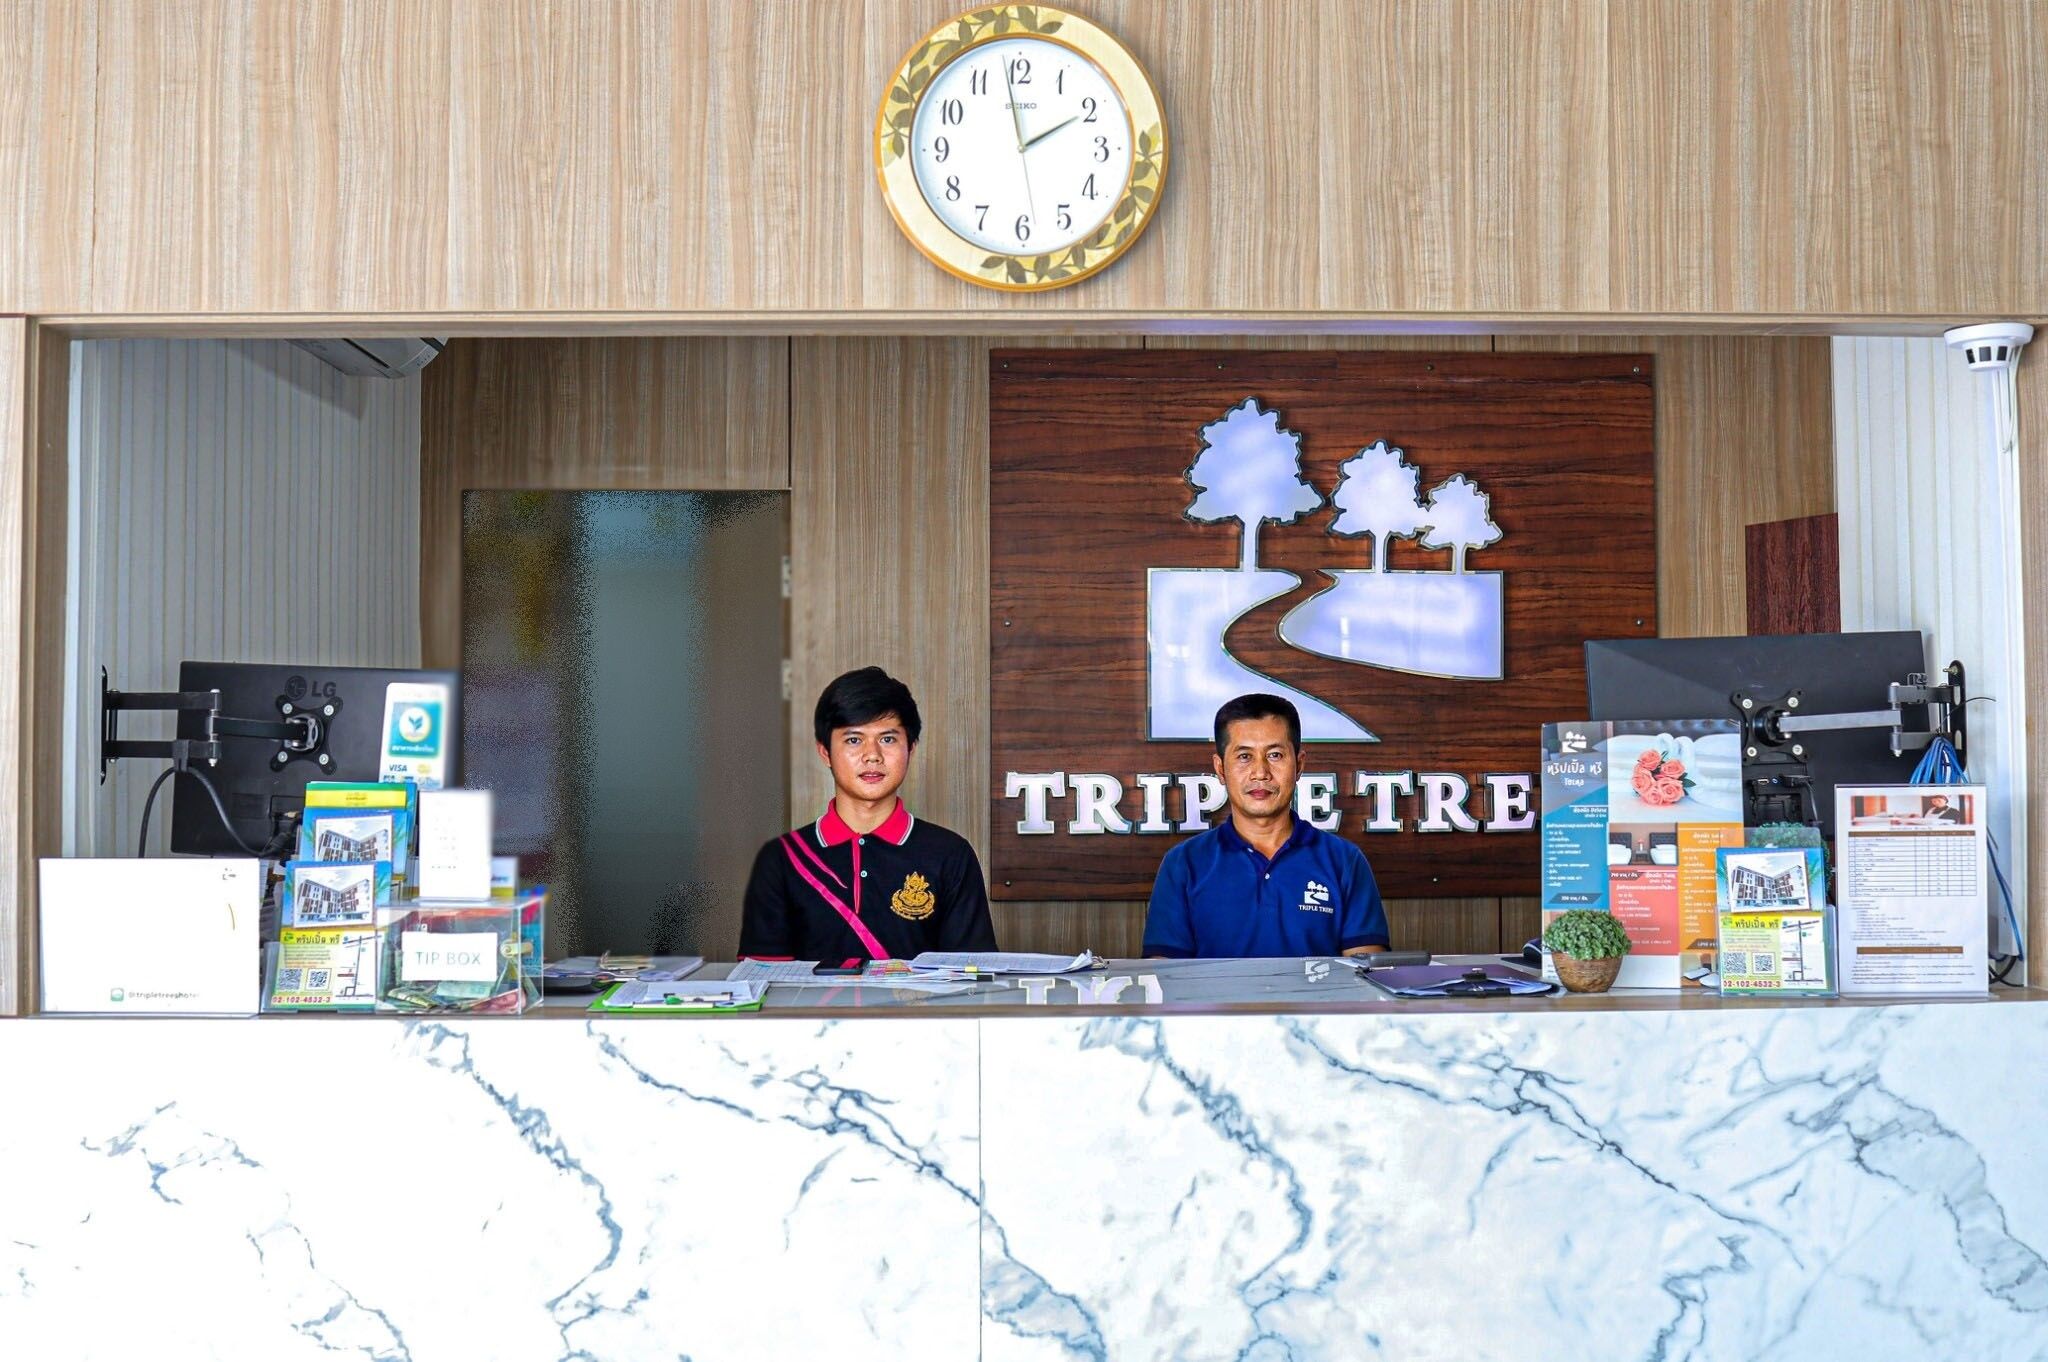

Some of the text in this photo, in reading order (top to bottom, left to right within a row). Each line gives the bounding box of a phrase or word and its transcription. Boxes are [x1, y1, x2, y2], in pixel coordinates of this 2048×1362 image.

[970, 69, 987, 95] 11
[1009, 58, 1031, 85] 12
[1056, 69, 1063, 95] 1
[941, 99, 963, 125] 10
[1081, 97, 1097, 123] 2
[934, 136, 949, 162] 9
[1094, 136, 1109, 162] 3
[946, 175, 961, 201] 8
[1081, 173, 1098, 200] 4
[975, 205, 989, 231] 7
[1015, 215, 1030, 241] 6
[1056, 204, 1071, 230] 5
[311, 681, 337, 698] LG
[389, 764, 408, 772] VISA
[1589, 761, 1602, 775] ทรี
[1006, 769, 1538, 835] TRIPE TRE
[1298, 904, 1319, 912] TRIPLE
[416, 951, 481, 965] TIP BOX
[1723, 980, 1781, 988] 02-102-4532-3
[272, 995, 331, 1003] 02-102-4532-3
